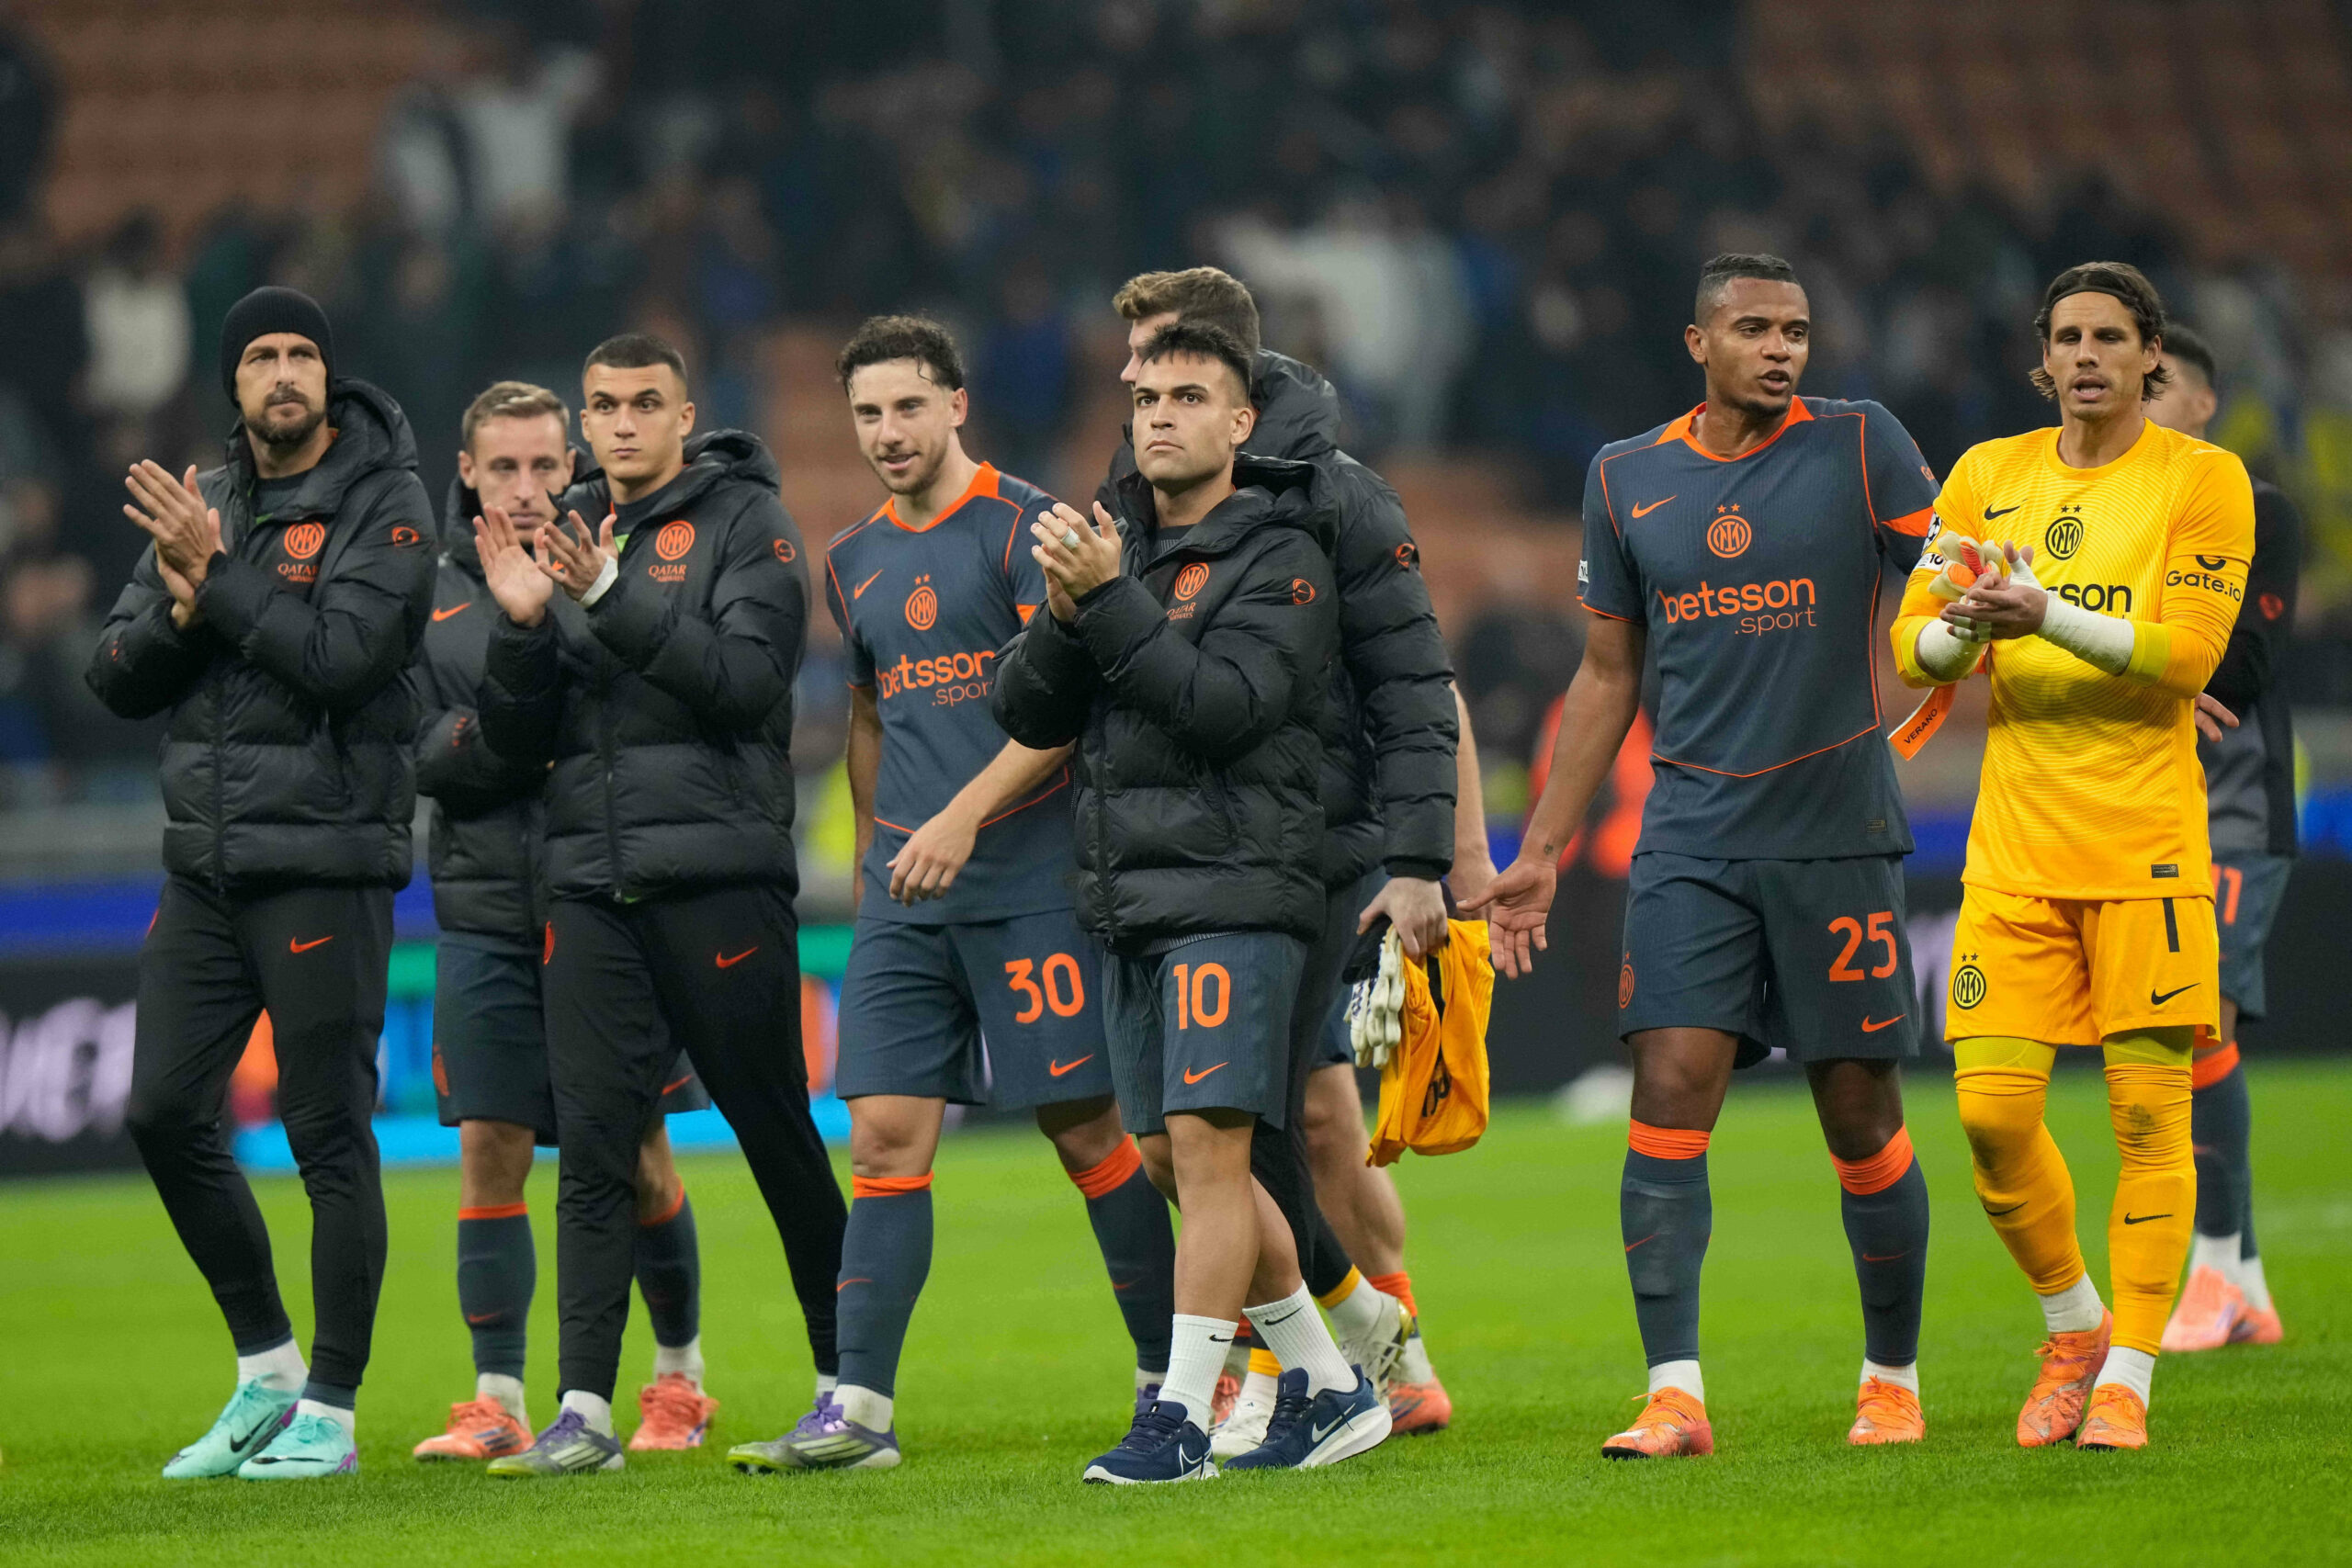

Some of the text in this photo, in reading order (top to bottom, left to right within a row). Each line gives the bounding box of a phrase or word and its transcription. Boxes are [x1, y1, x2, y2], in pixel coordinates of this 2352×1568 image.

[648, 563, 687, 578] QATAR
[2165, 570, 2242, 603] Gate.io
[1657, 577, 1816, 625] betsson
[1734, 606, 1817, 637] .sport
[931, 677, 995, 707] .spor
[1904, 708, 1938, 744] VERANO
[1827, 910, 1897, 982] 25
[1005, 953, 1085, 1024] 30
[1173, 962, 1231, 1030] 10
